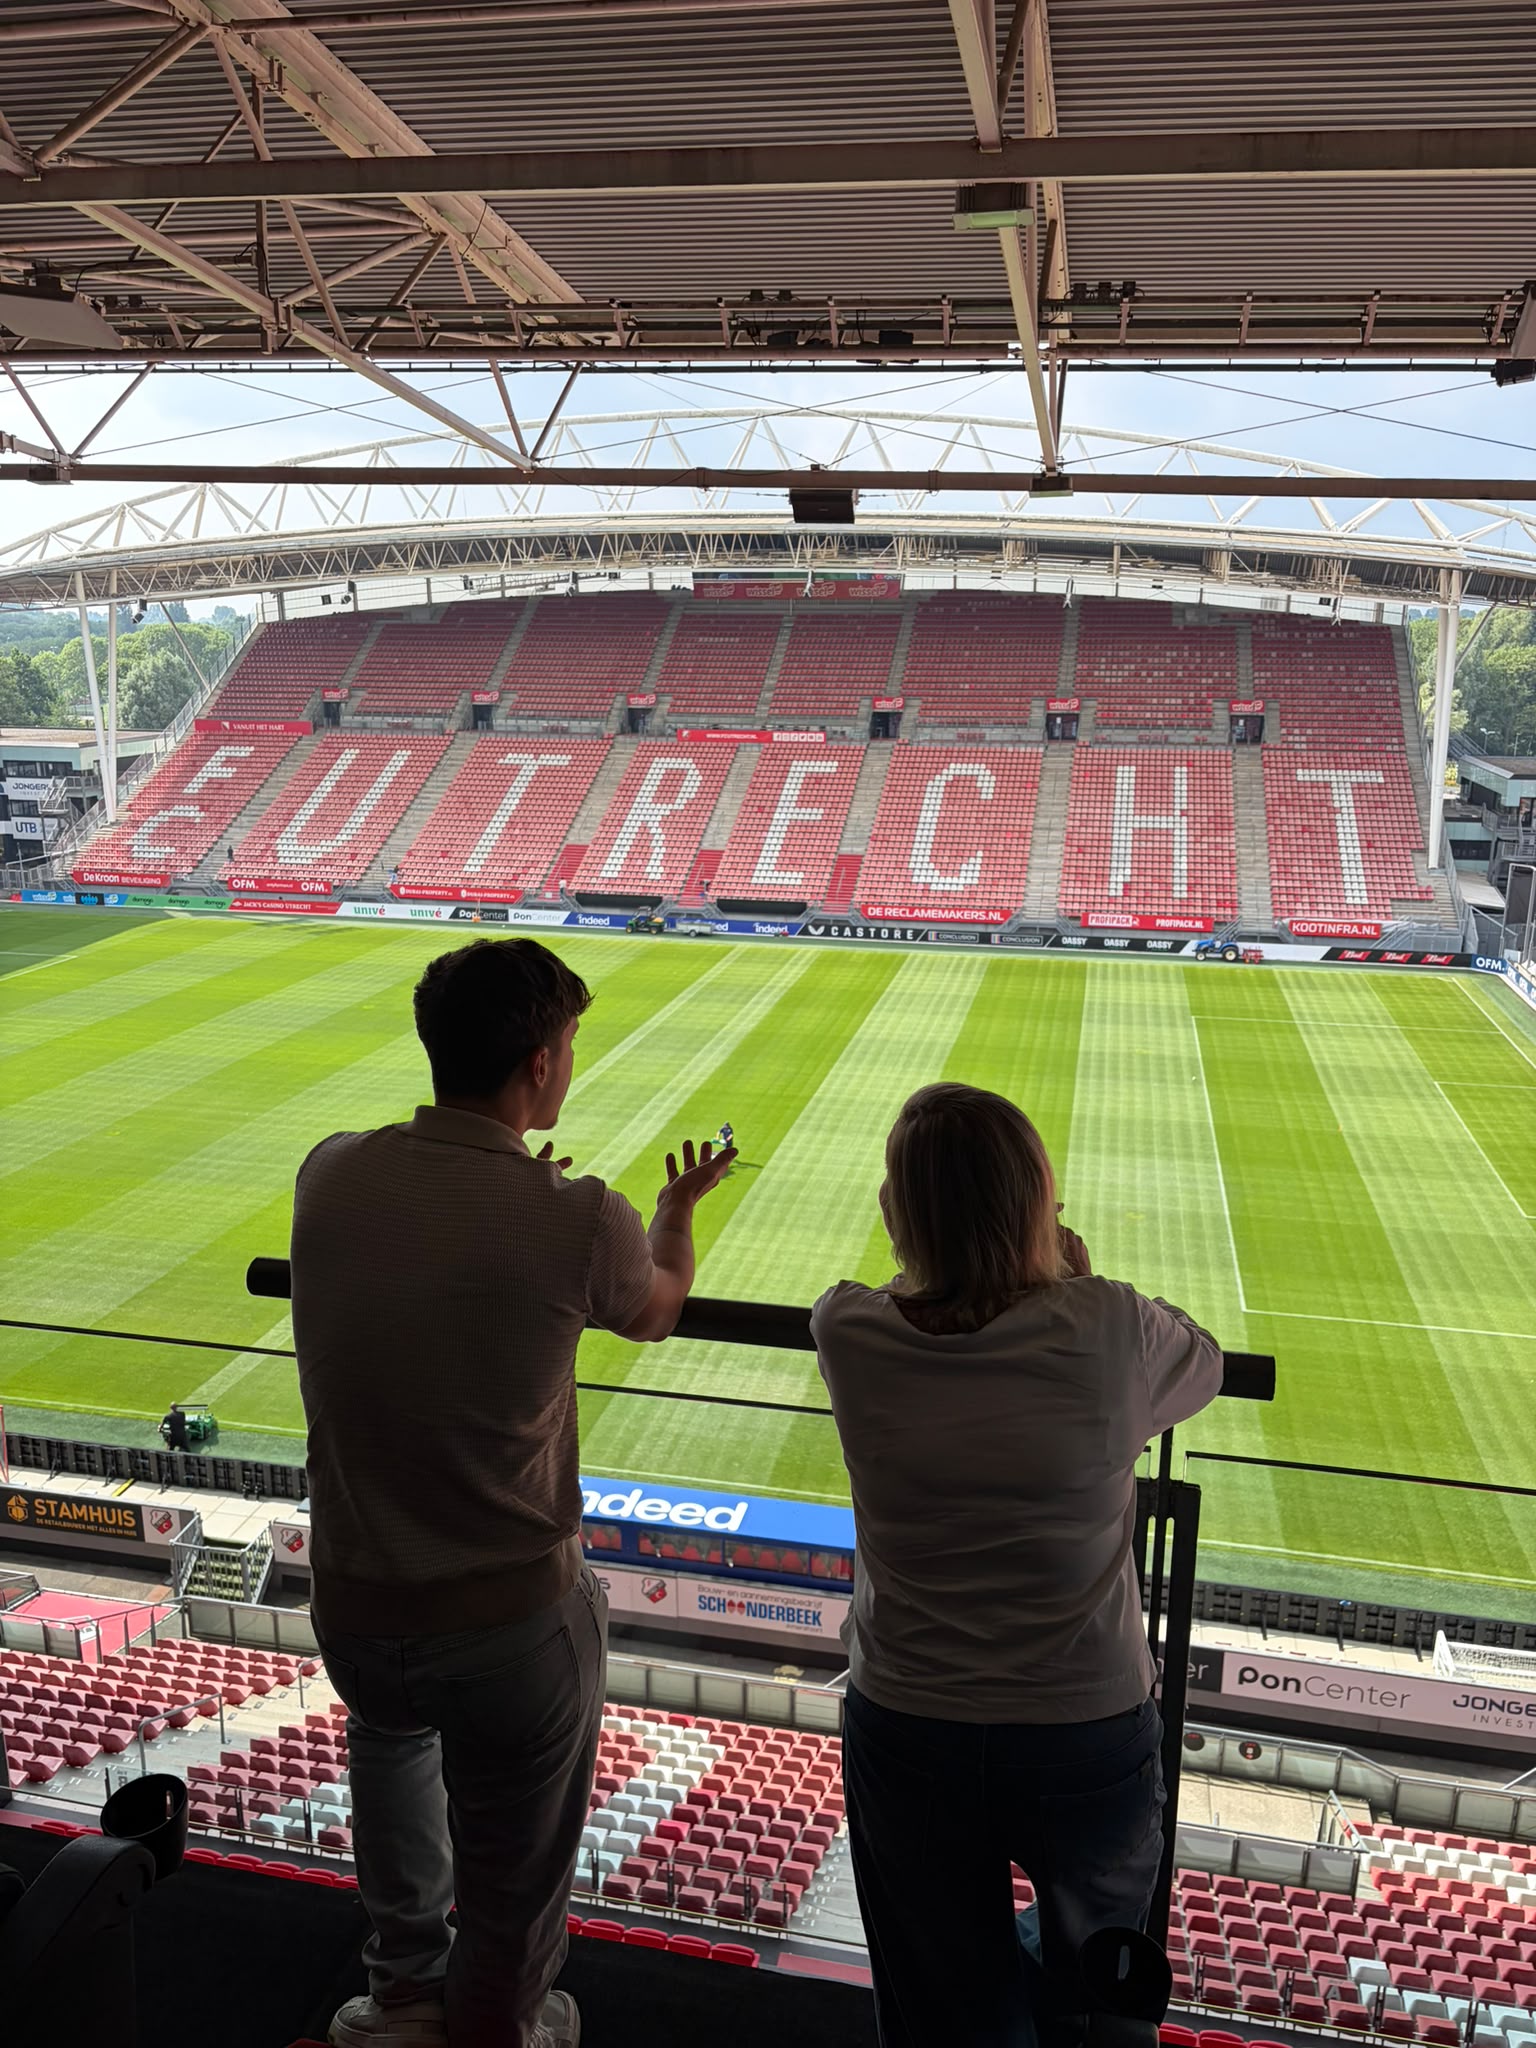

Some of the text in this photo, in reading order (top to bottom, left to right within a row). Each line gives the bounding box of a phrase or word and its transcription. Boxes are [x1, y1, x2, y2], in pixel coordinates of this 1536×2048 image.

[15, 822, 37, 833] UTB
[354, 905, 386, 916] univé
[410, 908, 442, 919] univé
[884, 908, 1004, 921] RECLAMEMAKERS.NL
[578, 914, 610, 926] indeed
[1090, 915, 1131, 926] PROFIPACK
[831, 926, 914, 940] CASTORE
[1292, 922, 1378, 936] KOOTINFRA.NL
[34, 1498, 136, 1528] STAMHUIS
[582, 1488, 748, 1531] ndeed
